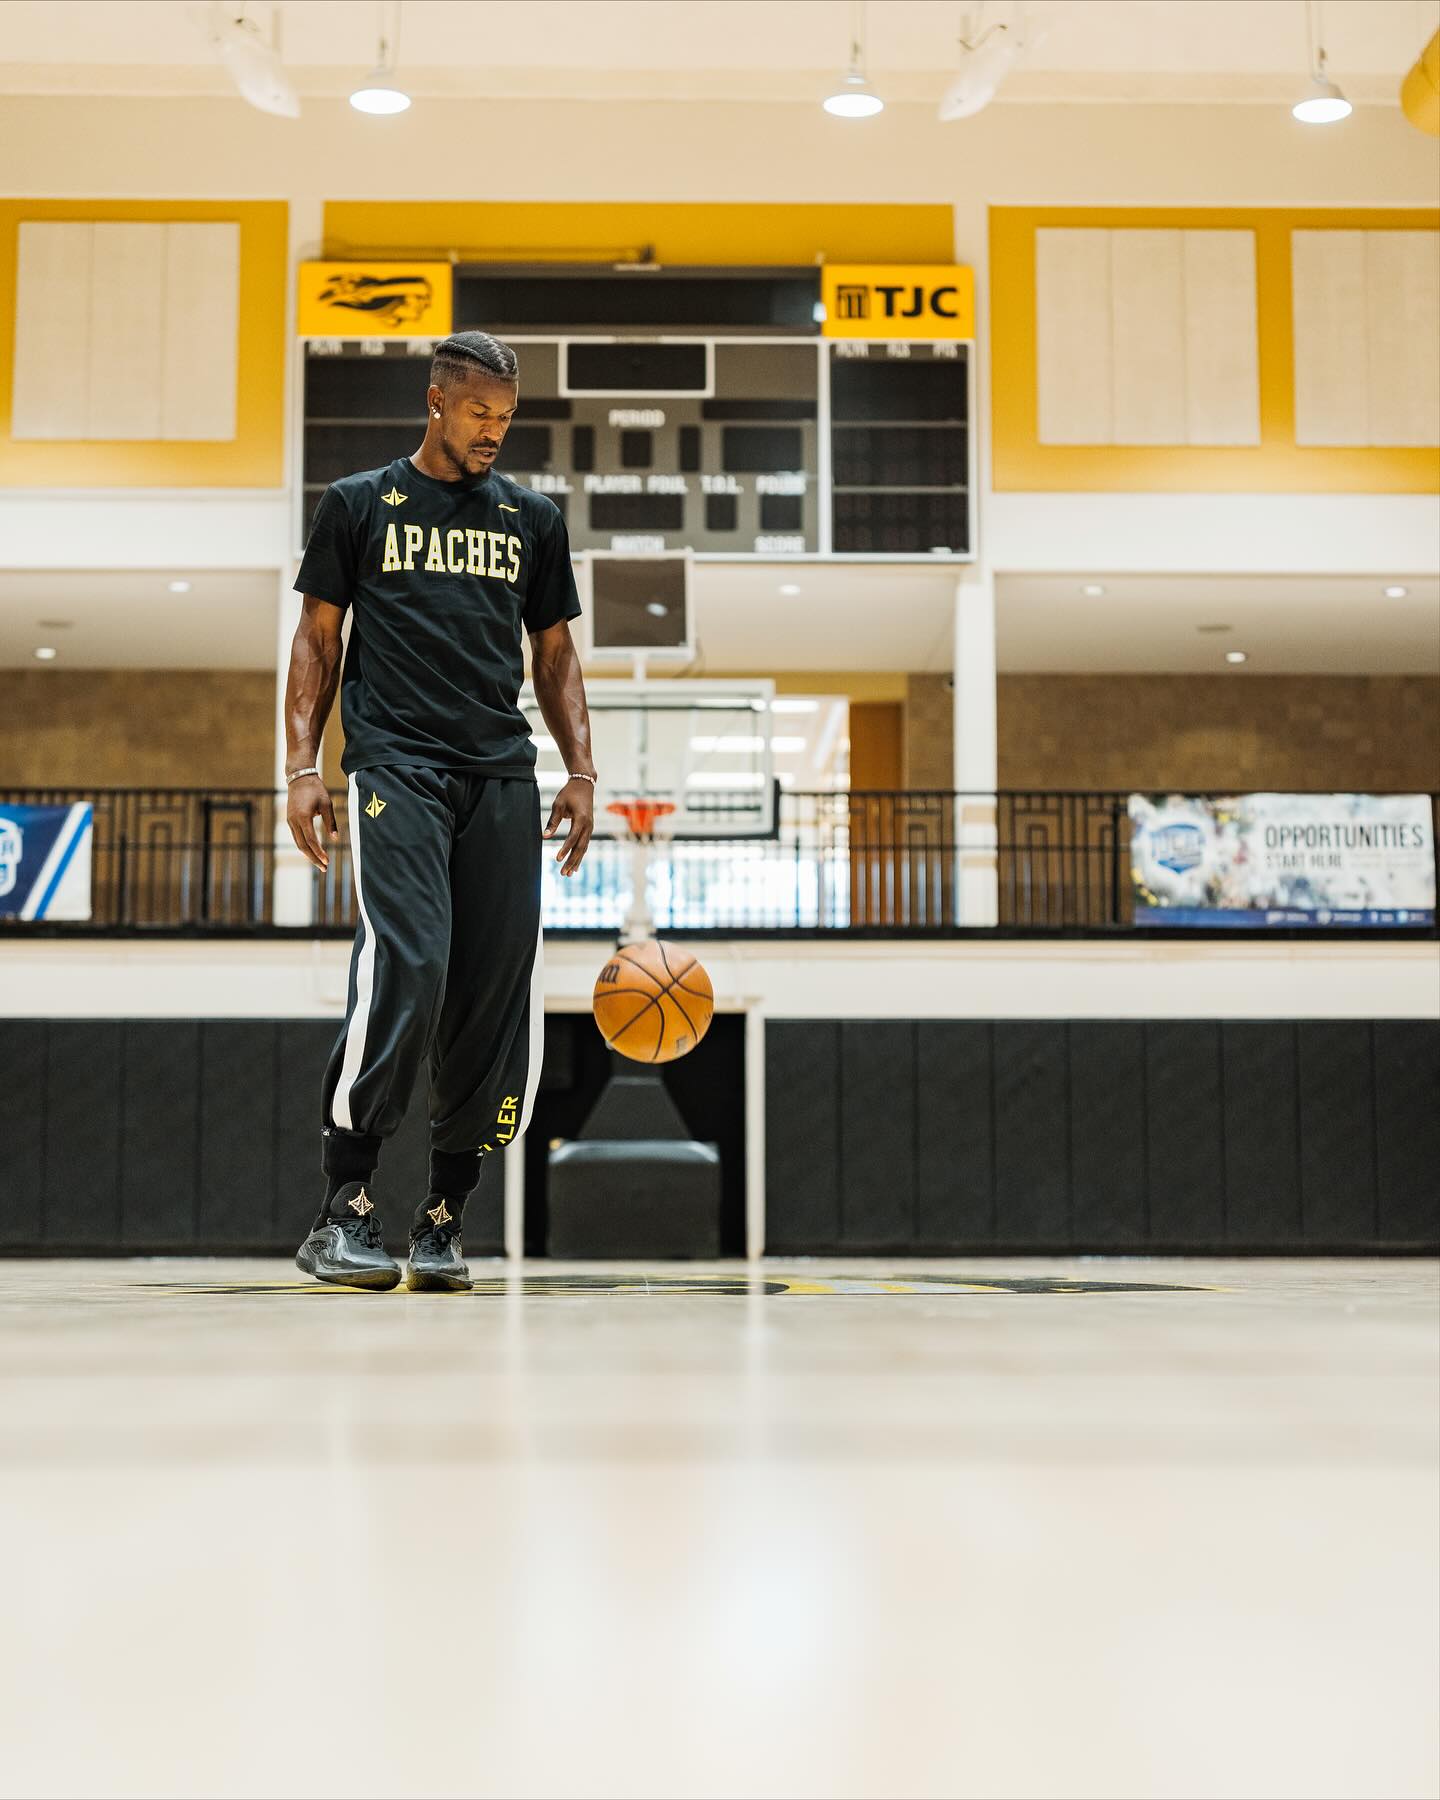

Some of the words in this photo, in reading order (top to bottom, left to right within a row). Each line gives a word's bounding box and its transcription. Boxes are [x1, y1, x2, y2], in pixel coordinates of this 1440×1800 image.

[876, 286, 959, 318] TJC
[608, 409, 666, 428] PERIOD
[583, 475, 642, 494] PLAYER
[382, 523, 522, 584] APACHES
[1265, 825, 1424, 849] OPPORTUNITIES
